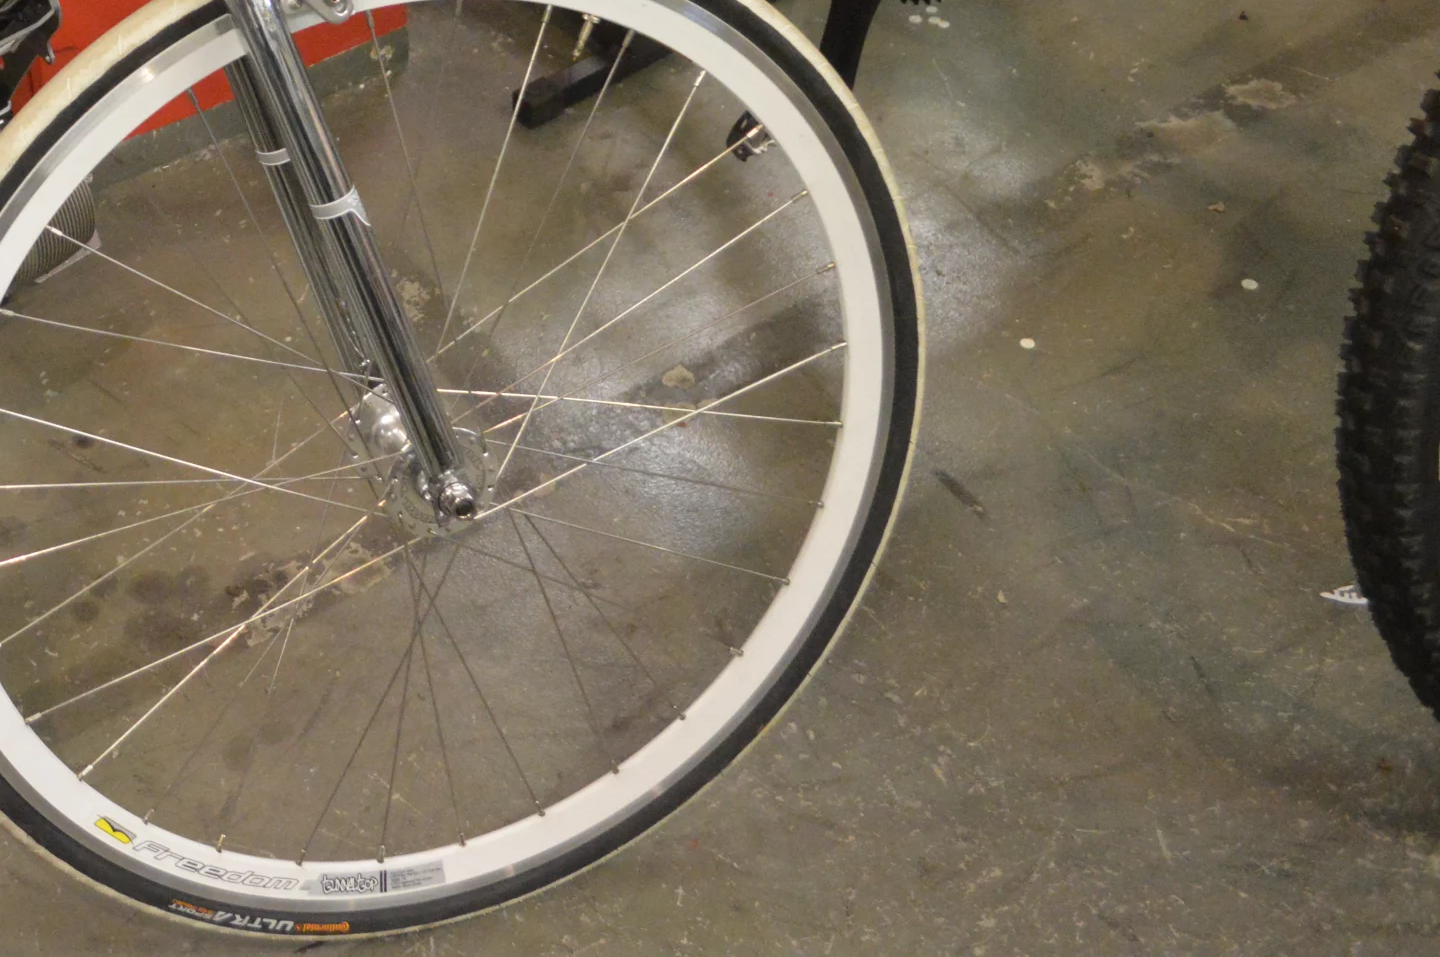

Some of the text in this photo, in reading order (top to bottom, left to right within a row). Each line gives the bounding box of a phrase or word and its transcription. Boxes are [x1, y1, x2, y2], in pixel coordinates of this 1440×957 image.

[133, 840, 300, 891] Freedom
[168, 901, 213, 922] SPORT
[212, 909, 296, 933] ULTRA
[302, 921, 351, 934] Continental
